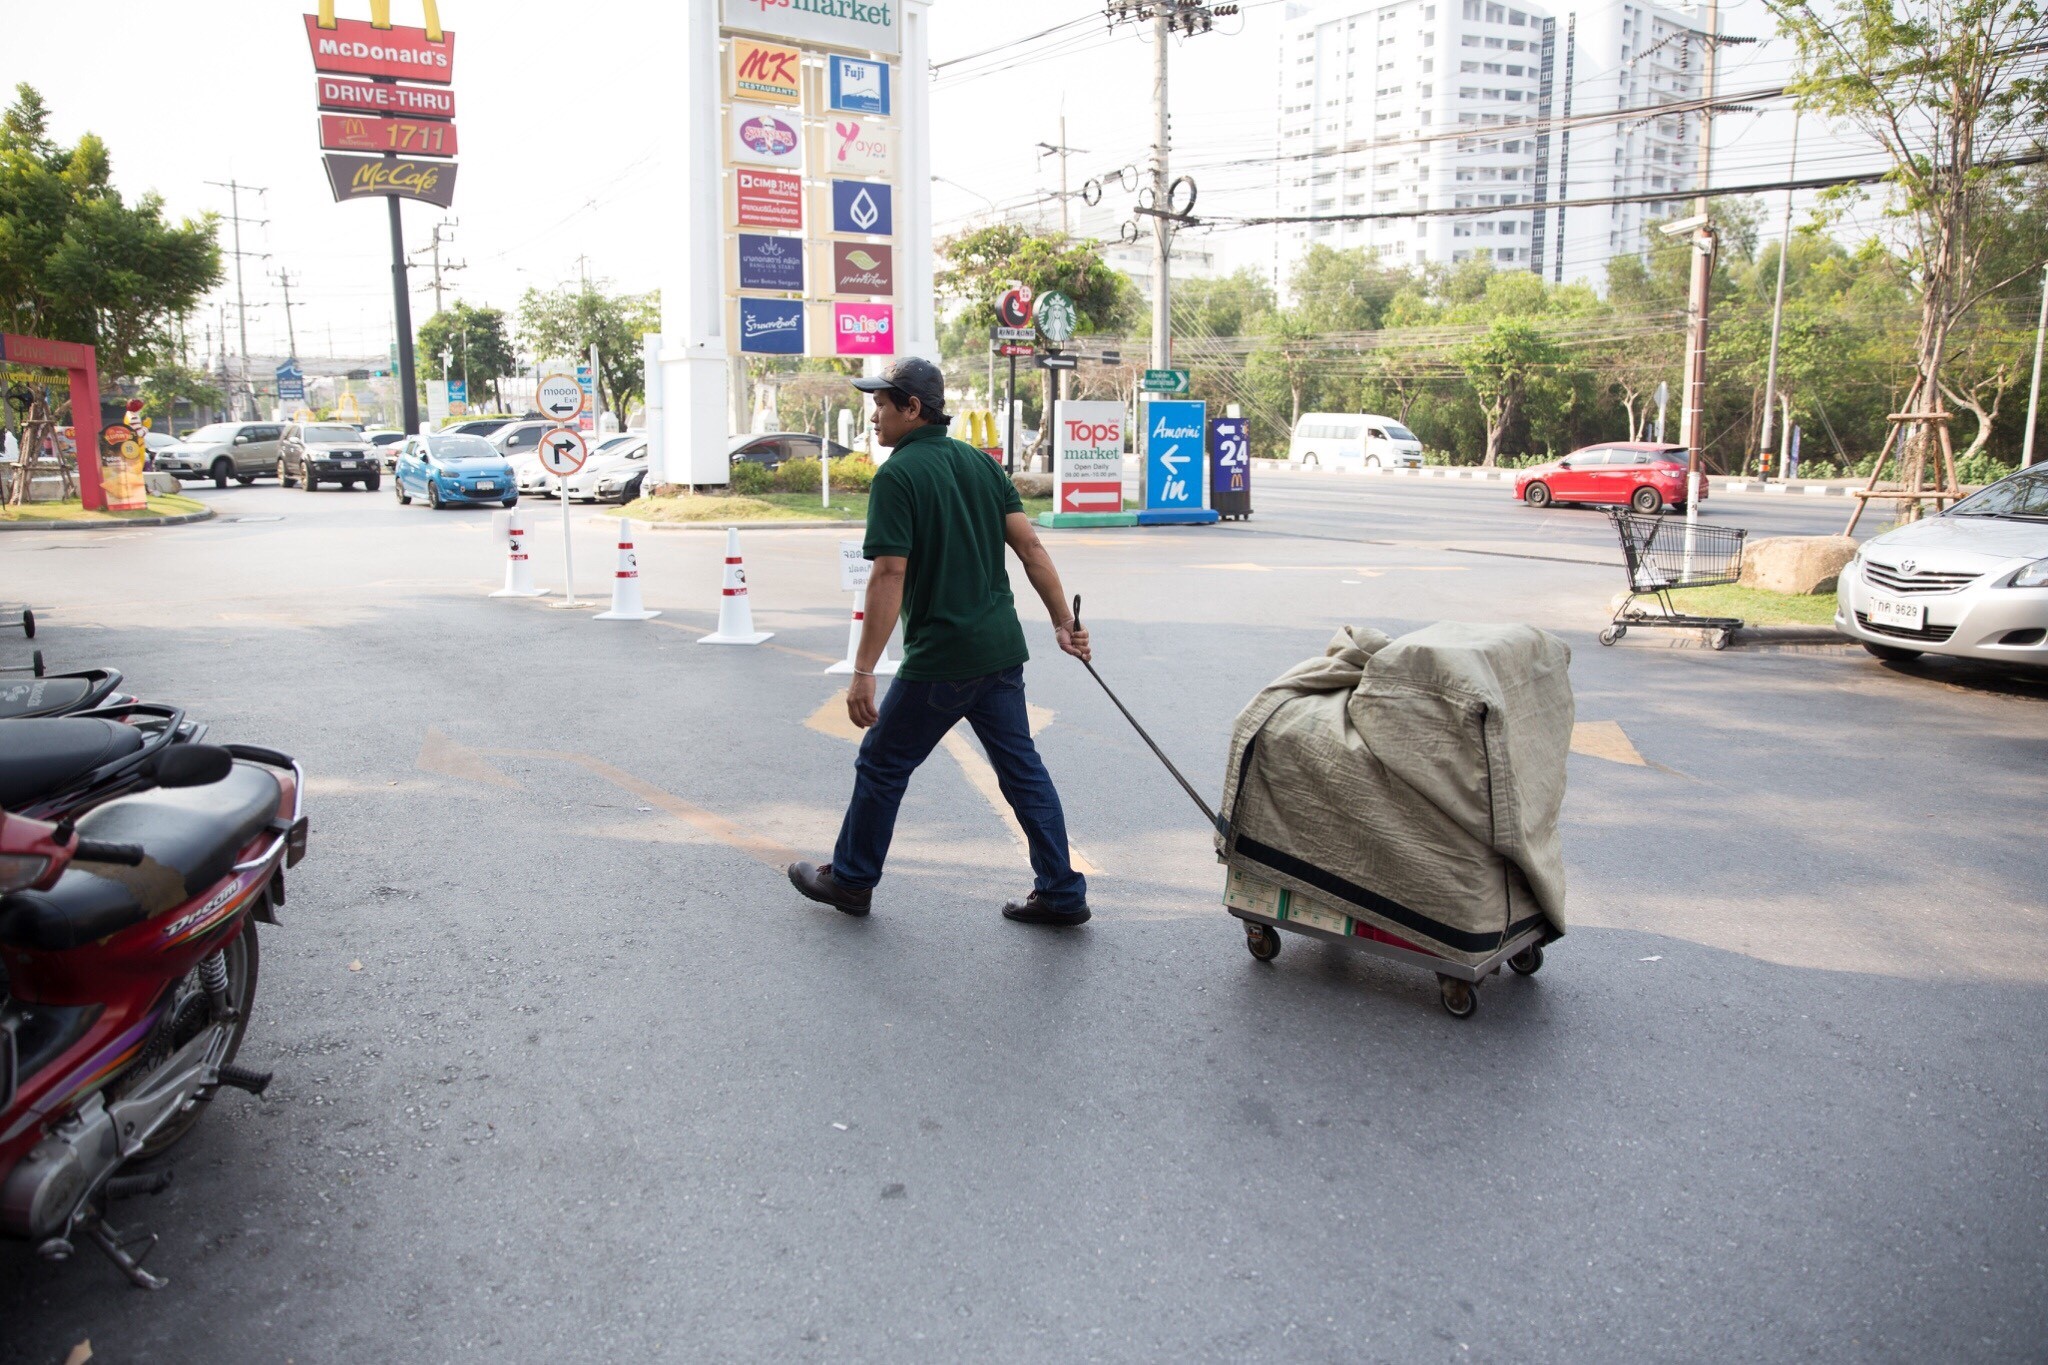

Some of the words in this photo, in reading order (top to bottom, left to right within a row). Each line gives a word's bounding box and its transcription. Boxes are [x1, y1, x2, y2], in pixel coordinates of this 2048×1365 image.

[792, 0, 891, 26] market
[318, 38, 448, 67] McDonald's
[739, 48, 798, 84] MK
[844, 64, 864, 81] Fuji
[325, 83, 450, 110] DRIVE-THRU
[739, 81, 798, 97] RESTAURANTS
[386, 123, 444, 150] 1711
[836, 121, 887, 161] Yayoi
[753, 177, 777, 189] CIMB
[778, 180, 799, 191] THAI
[840, 314, 889, 334] Daiso
[1064, 420, 1120, 448] Tops
[1152, 416, 1201, 439] Amorini
[1064, 446, 1120, 460] market
[1220, 440, 1248, 466] 24
[1074, 463, 1091, 471] Open
[1093, 463, 1110, 471] Daily
[1161, 474, 1189, 502] in
[1895, 604, 1918, 617] 9629
[162, 880, 239, 937] Dream
